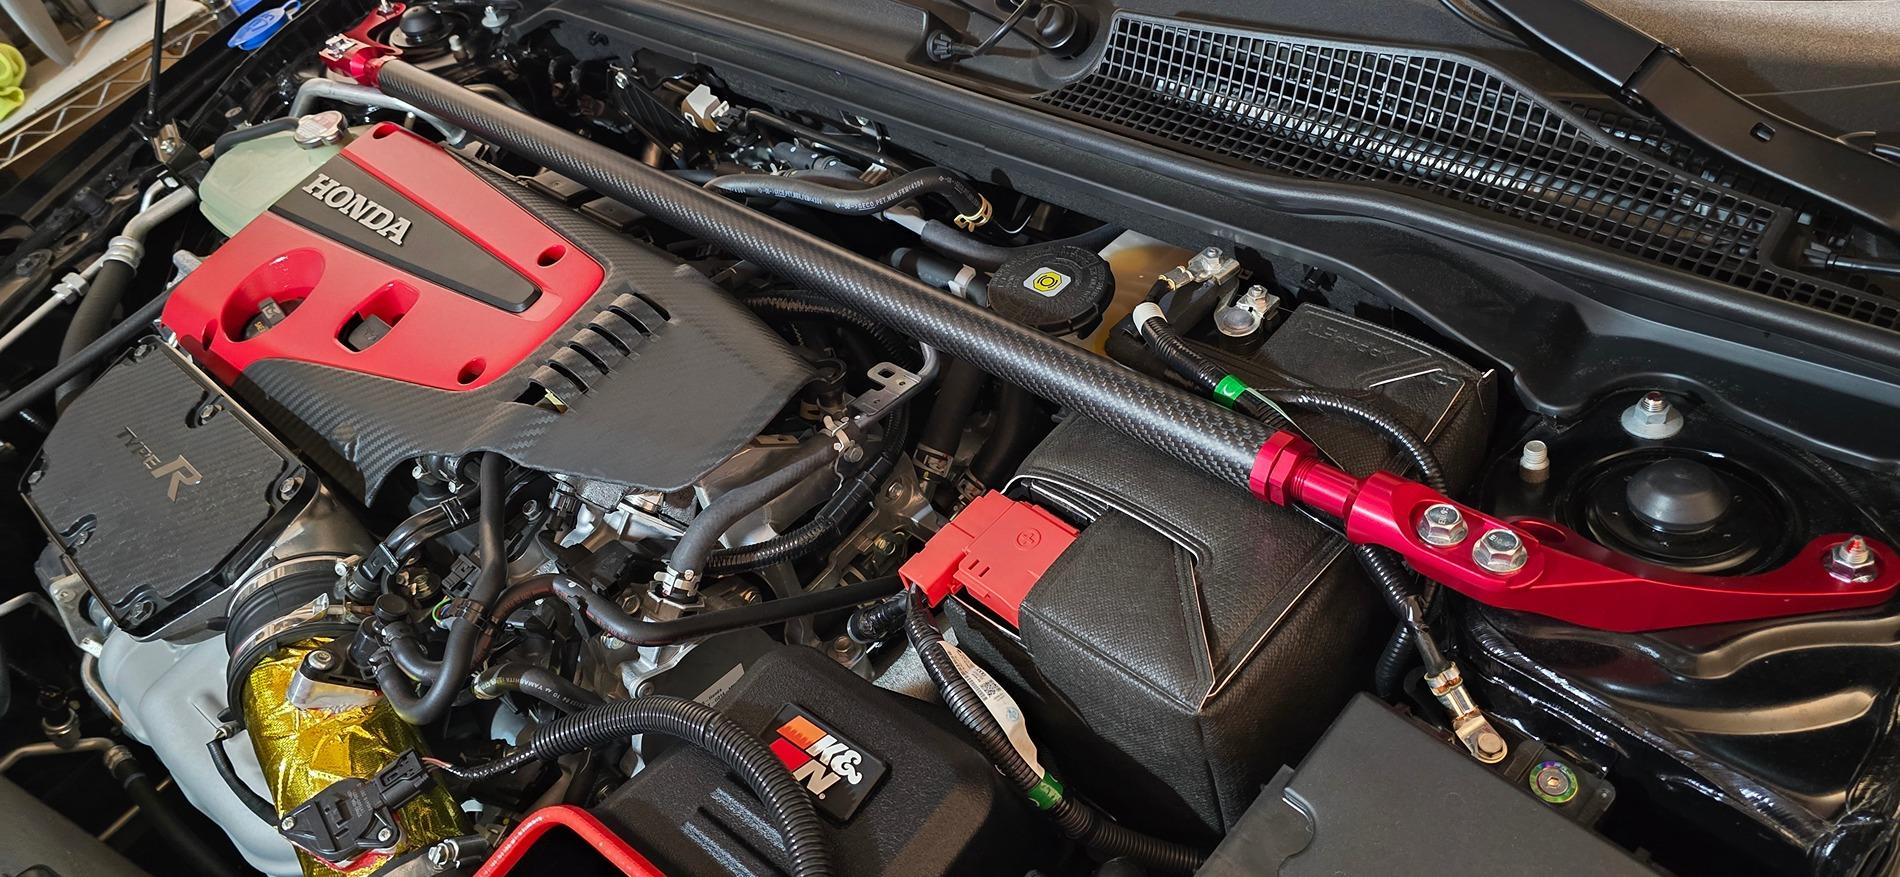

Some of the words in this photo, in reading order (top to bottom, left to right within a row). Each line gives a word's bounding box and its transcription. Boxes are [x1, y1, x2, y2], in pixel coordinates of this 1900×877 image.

[302, 173, 412, 246] HONDA
[116, 426, 161, 470] TYPE
[150, 454, 204, 502] R
